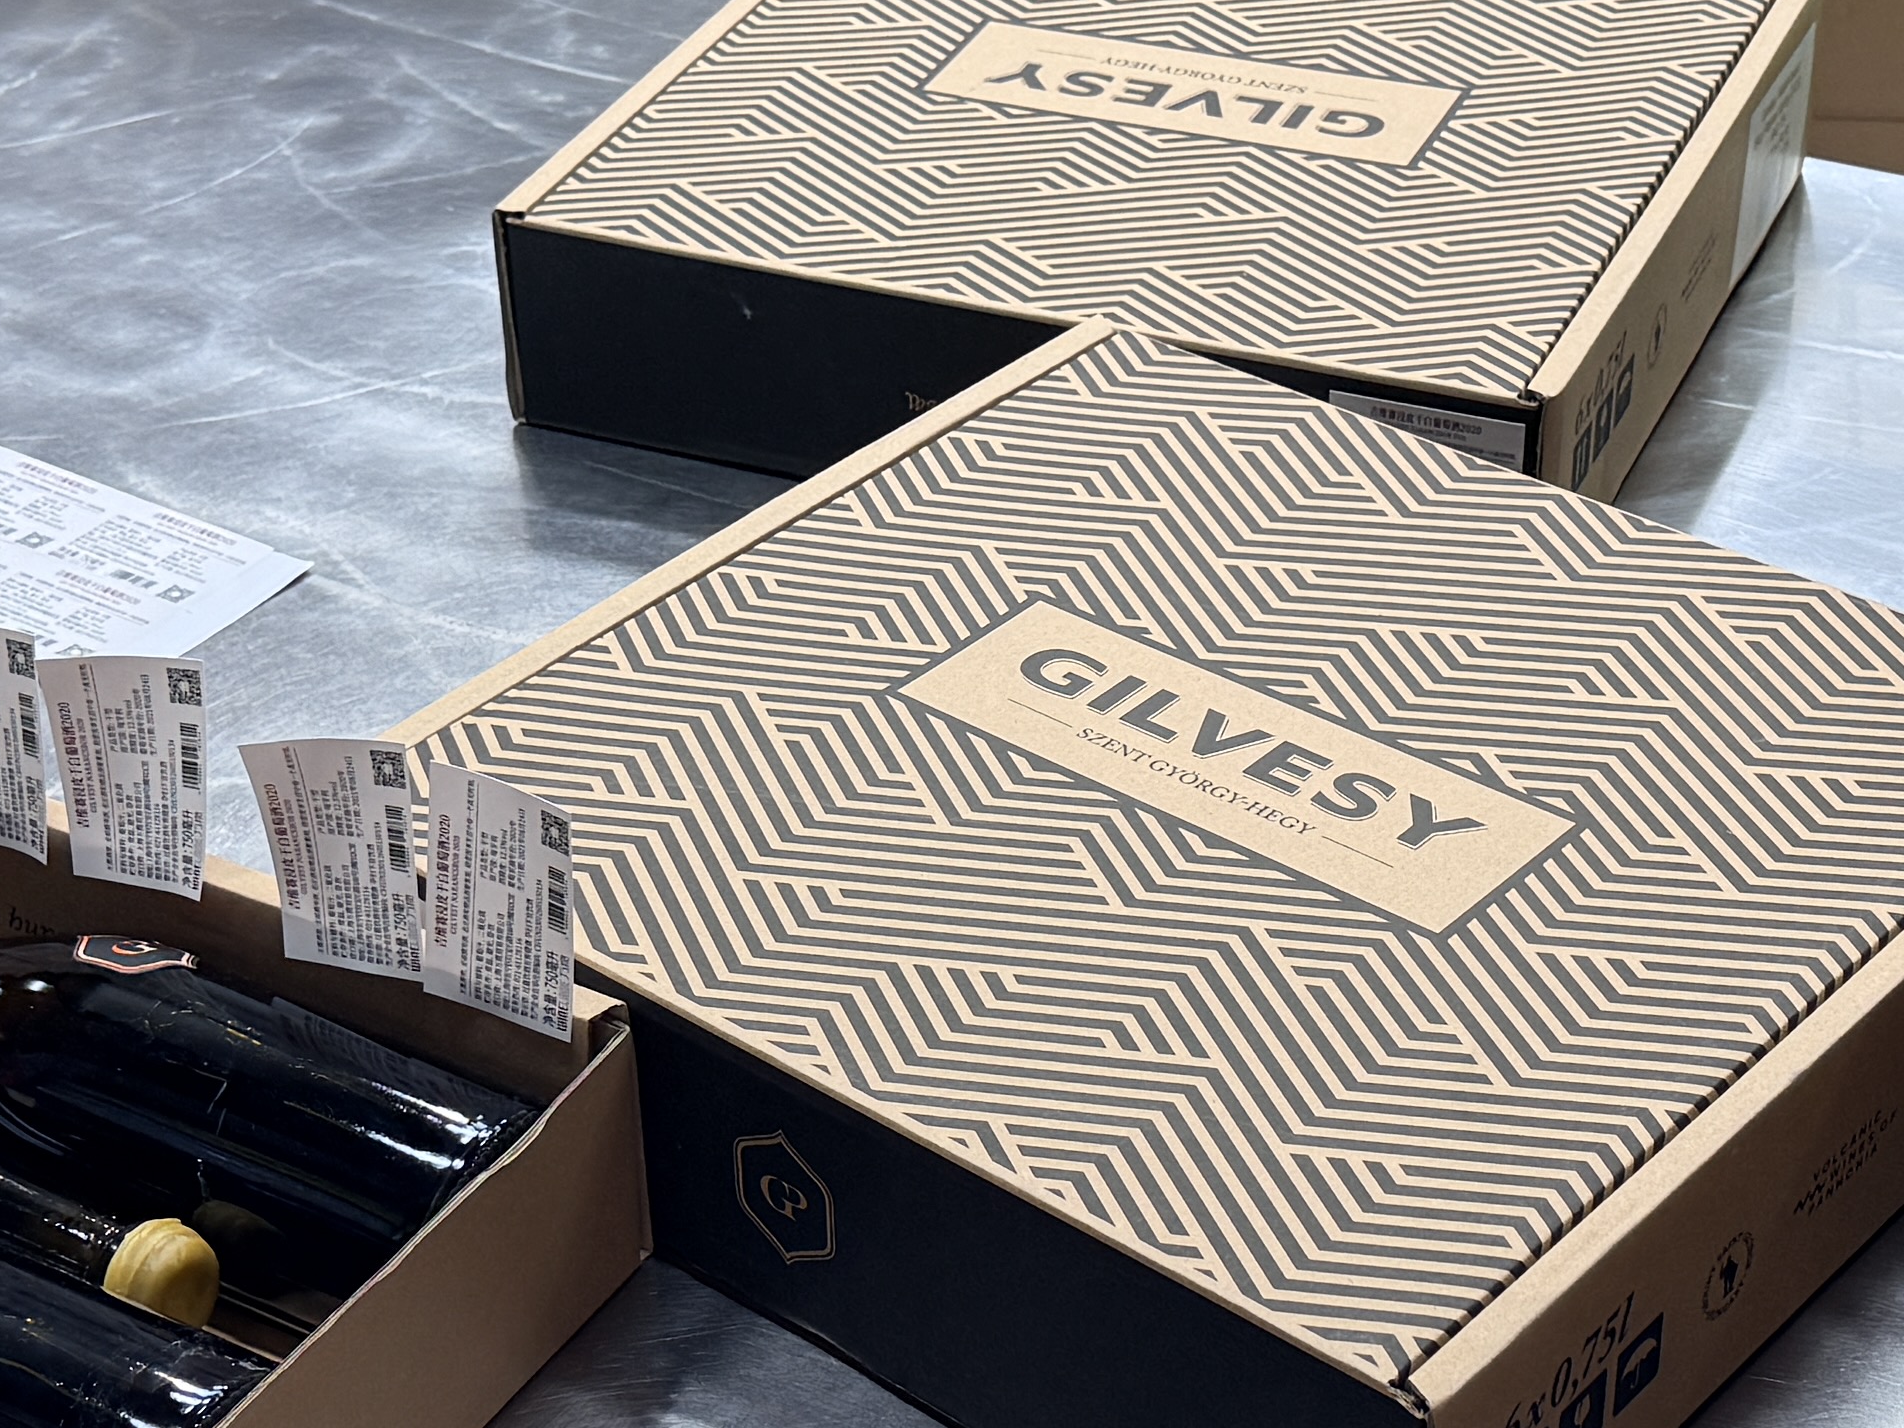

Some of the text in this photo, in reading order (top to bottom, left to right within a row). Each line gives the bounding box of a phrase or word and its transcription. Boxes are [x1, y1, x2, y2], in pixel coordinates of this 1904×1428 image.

[984, 61, 1385, 139] GILVESY
[1020, 648, 1488, 850] GILVESY
[1076, 728, 1316, 836] SZENT GYÖRGY-HEGY
[1813, 1109, 1883, 1181] VOLCANIC
